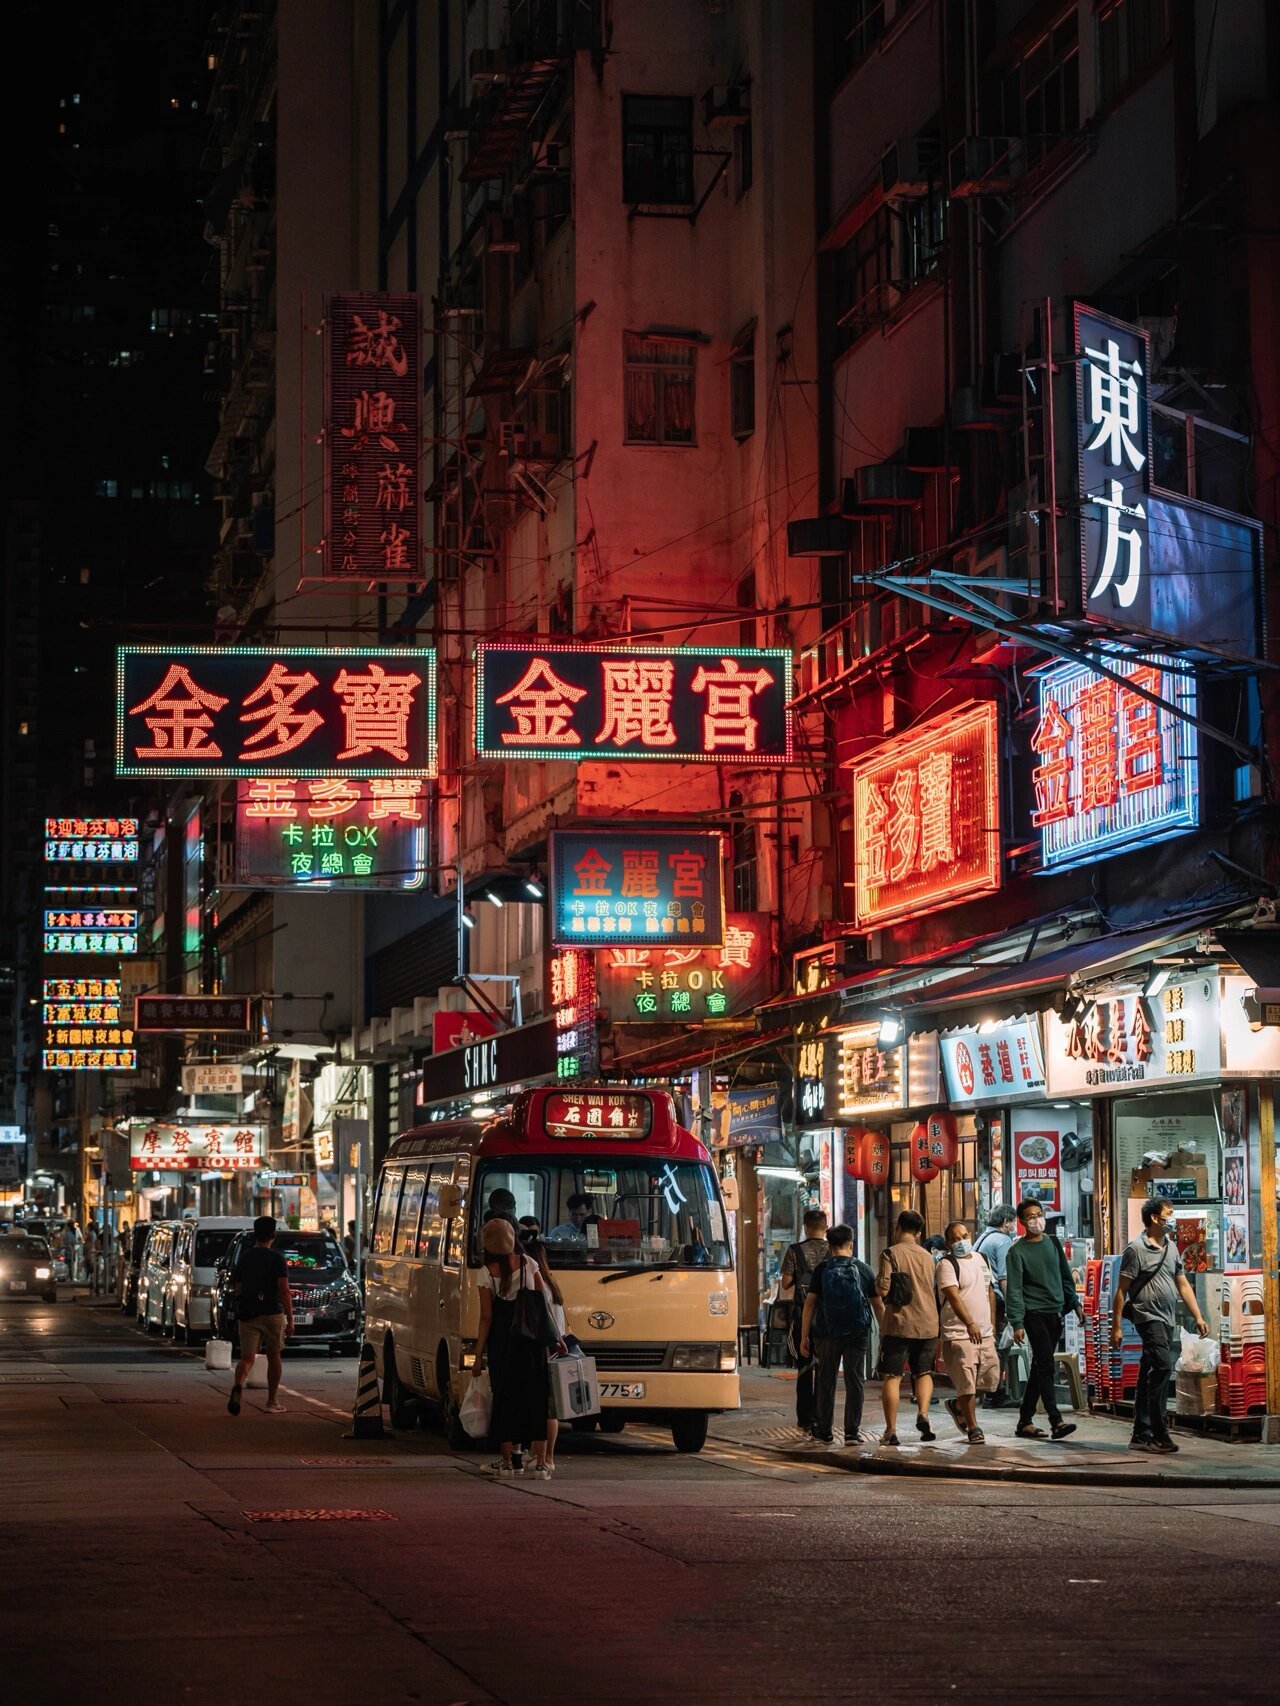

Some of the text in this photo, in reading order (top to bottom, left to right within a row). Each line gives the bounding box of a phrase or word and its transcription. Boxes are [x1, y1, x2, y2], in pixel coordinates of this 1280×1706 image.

[1084, 339, 1147, 608] 東方
[129, 662, 422, 762] 金多寶
[496, 657, 775, 751] 金麗宮
[861, 751, 955, 891] 金多寶
[282, 824, 378, 847] 卡拉OK
[291, 852, 374, 875] 夜總會
[573, 847, 706, 899] 金麗宮
[636, 970, 725, 990] 卡拉OK
[636, 992, 726, 1013] 夜總會
[563, 1094, 625, 1106] SHEK WAI KOK
[141, 1128, 256, 1155] 摩登賓館
[197, 1157, 260, 1168] HOTEL
[1018, 1167, 1057, 1178] 即叫即做
